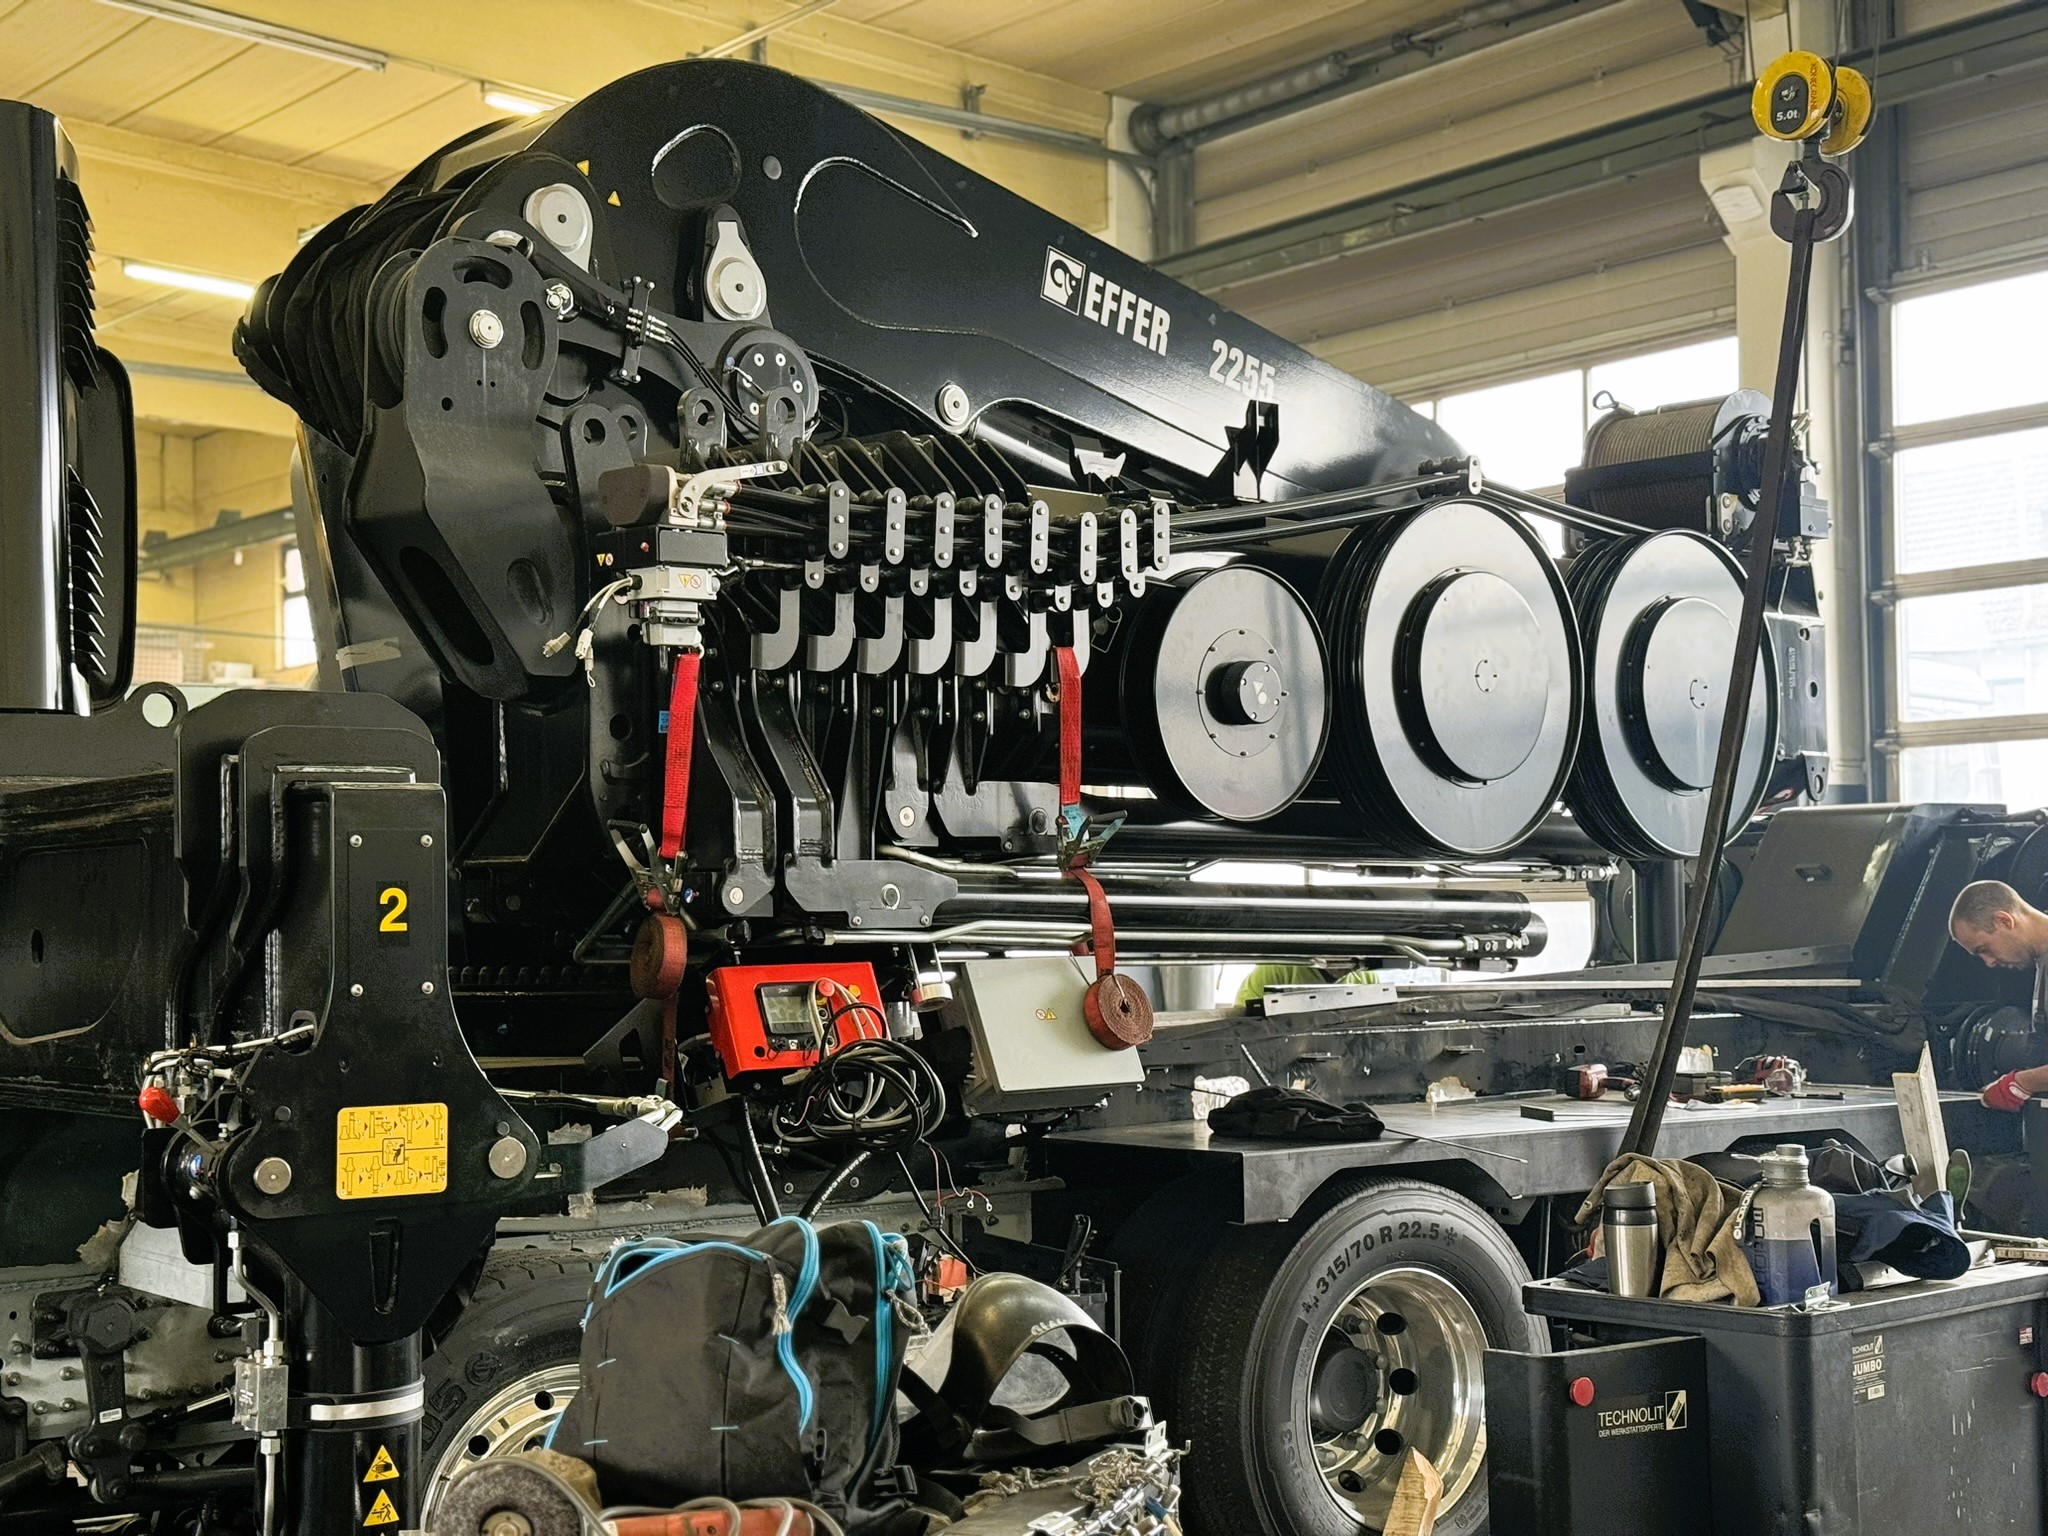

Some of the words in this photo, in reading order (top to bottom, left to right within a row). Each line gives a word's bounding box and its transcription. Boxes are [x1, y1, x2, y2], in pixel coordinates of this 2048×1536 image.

[1810, 63, 1819, 115] KONECRANE
[1776, 109, 1798, 121] 5.0t
[1083, 271, 1171, 357] EFFER
[1209, 339, 1276, 400] 2255
[380, 887, 407, 931] 2
[1316, 1233, 1375, 1295] 315/70
[1379, 1225, 1393, 1245] R
[1398, 1220, 1441, 1241] 22.5
[1853, 1358, 1883, 1377] JUMBO
[1597, 1405, 1665, 1428] TECHNOLIT
[1598, 1429, 1611, 1438] DER
